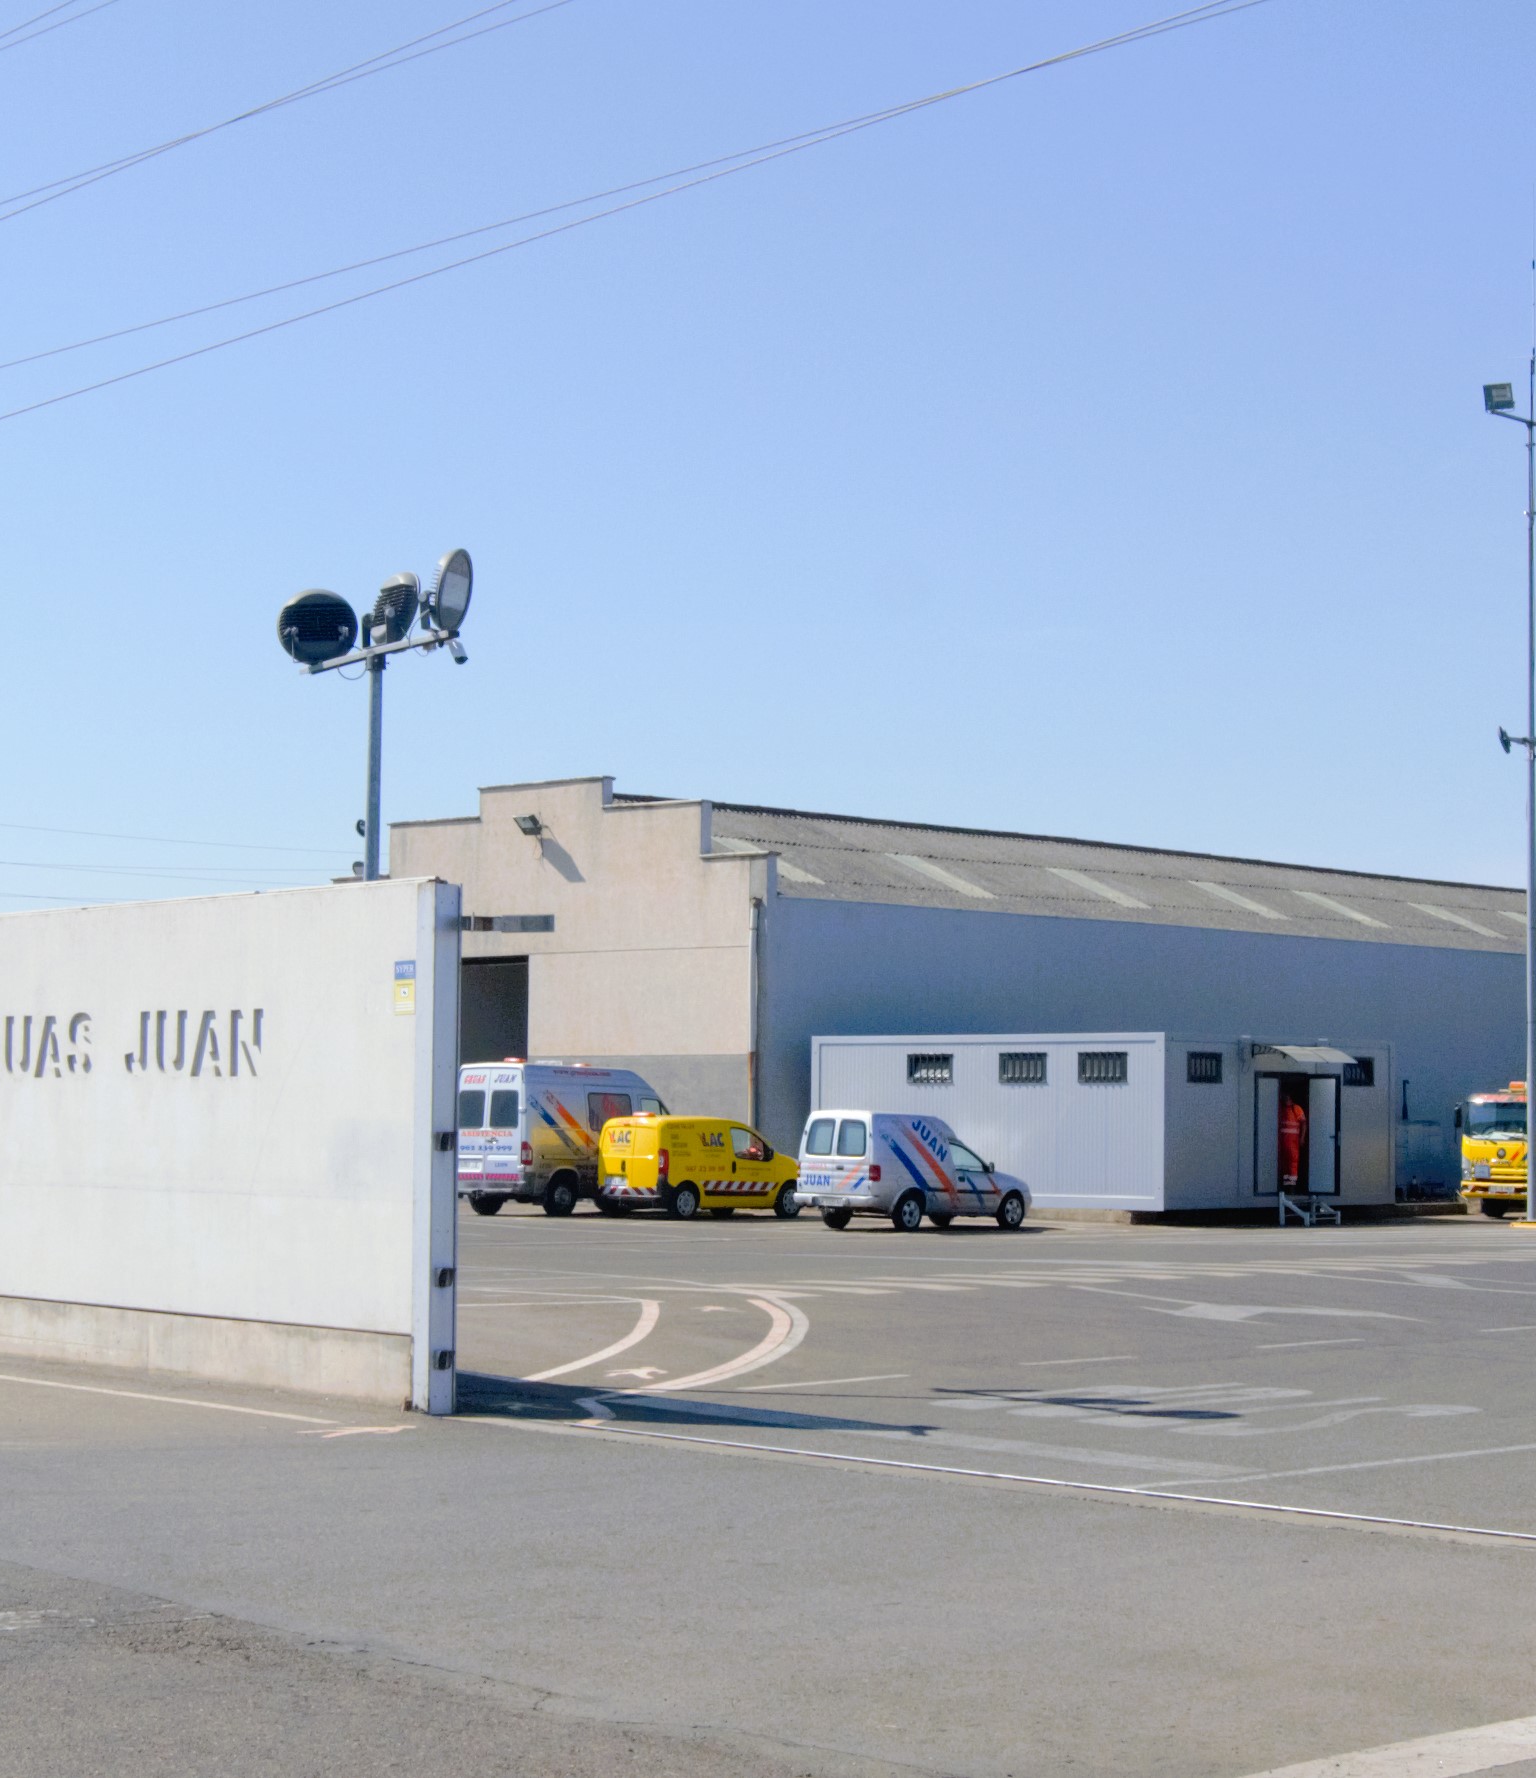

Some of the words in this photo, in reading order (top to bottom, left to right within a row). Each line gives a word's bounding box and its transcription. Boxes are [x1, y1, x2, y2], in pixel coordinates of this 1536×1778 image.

[124, 1008, 264, 1078] JUAN
[911, 1119, 948, 1162] JUAN
[804, 1174, 831, 1186] JUAN
